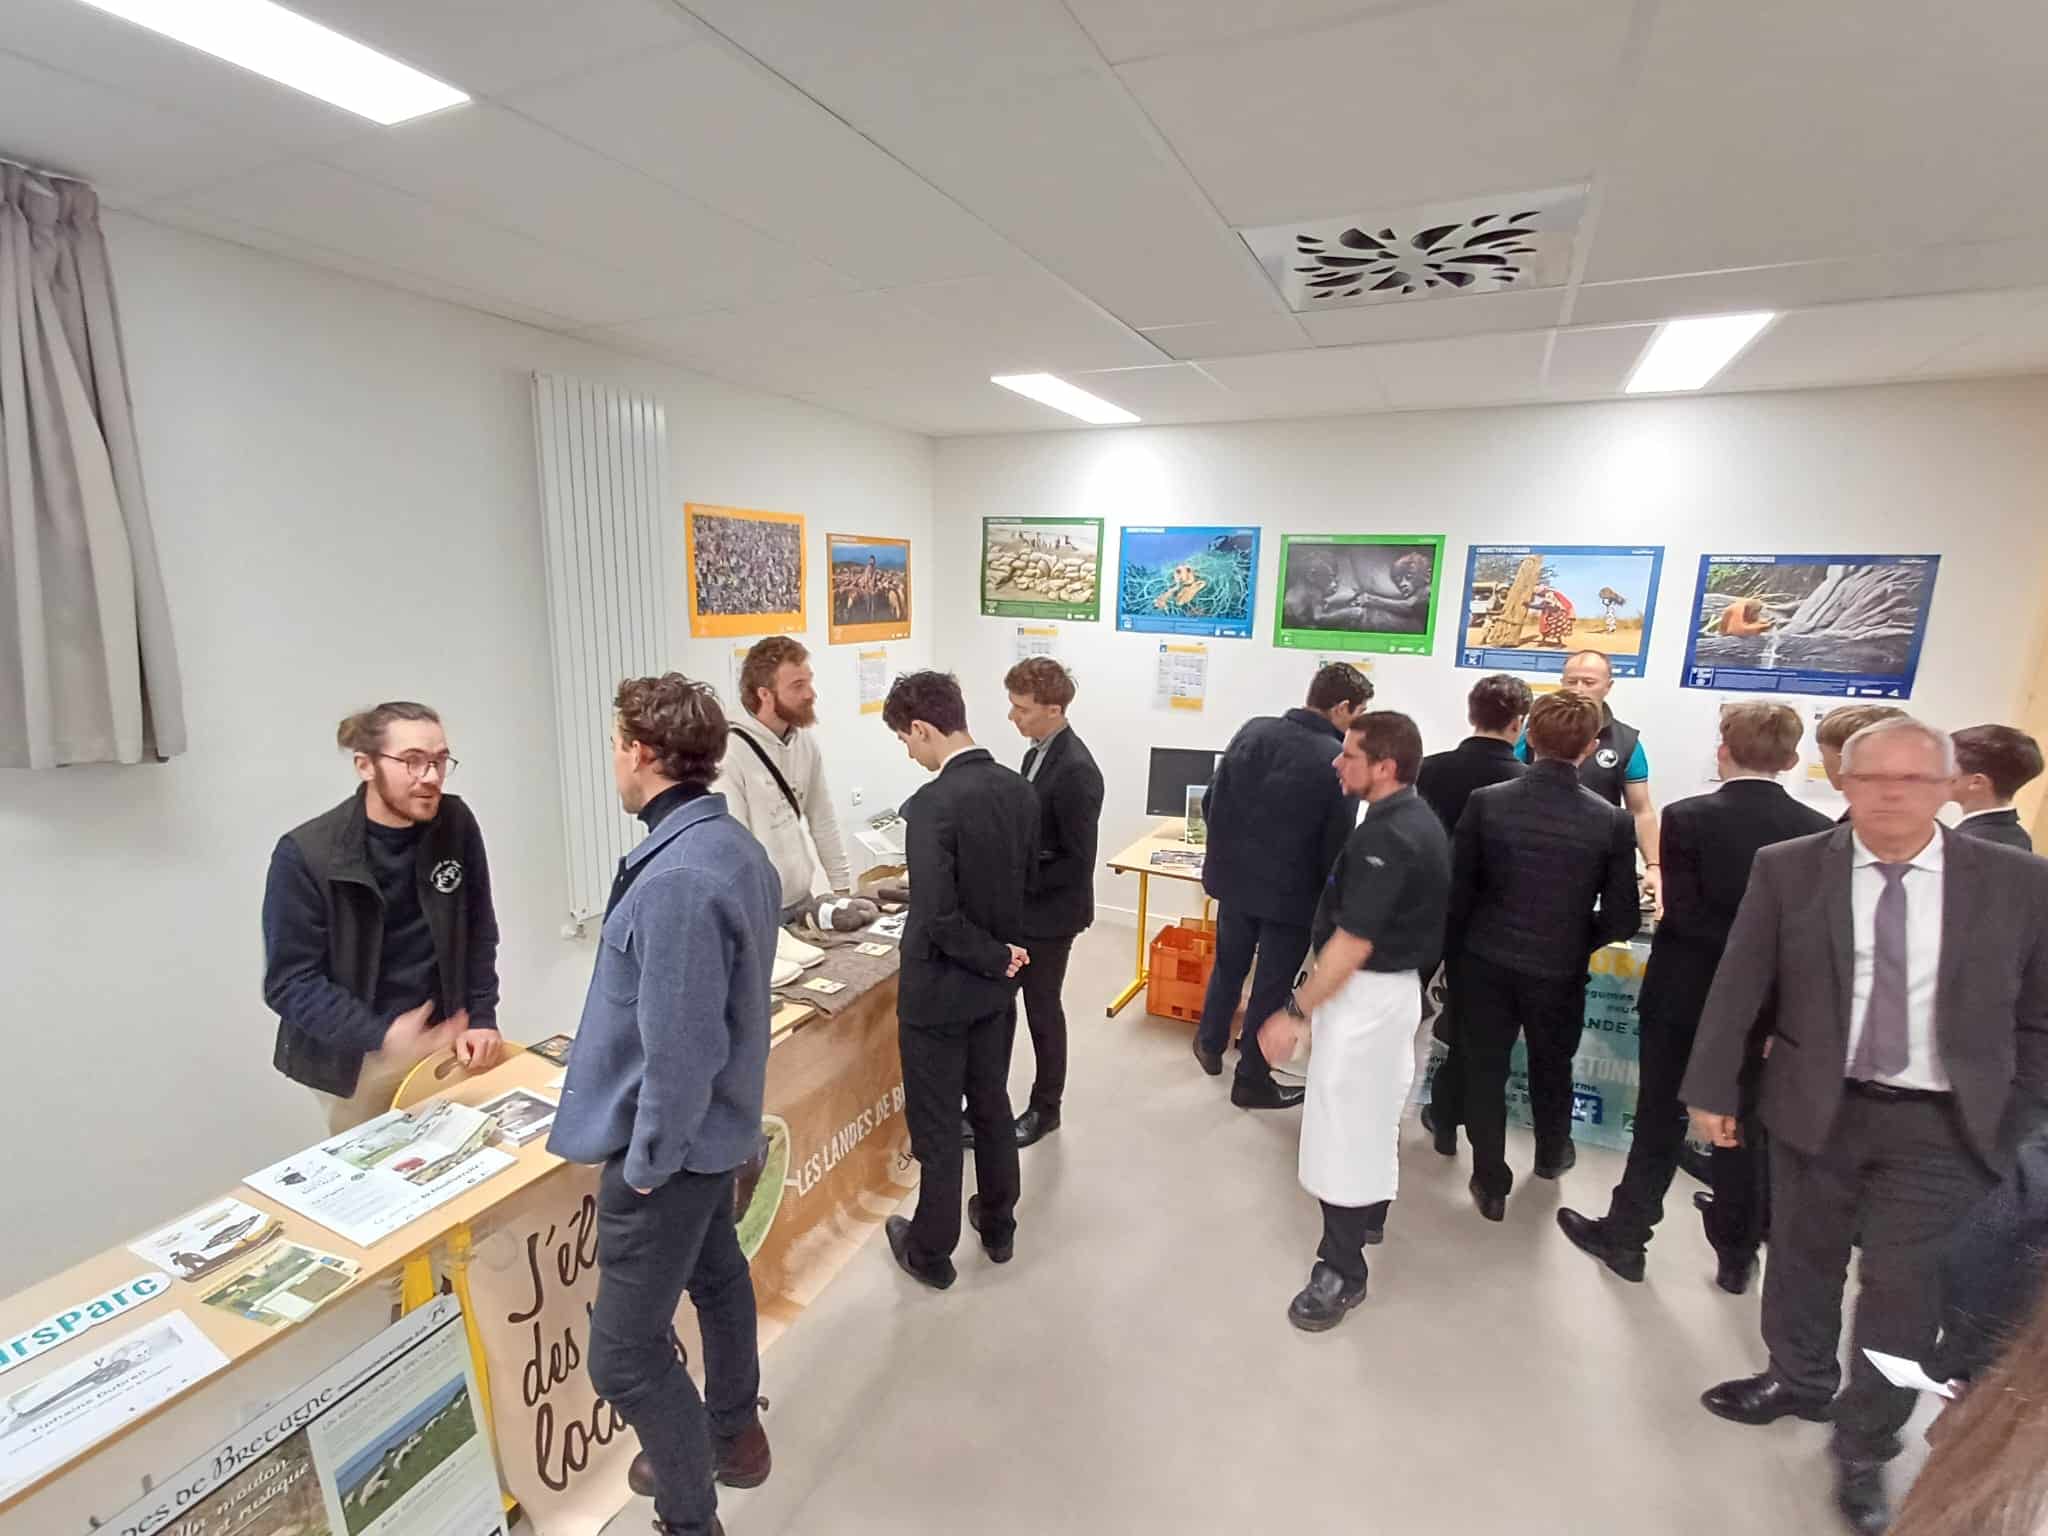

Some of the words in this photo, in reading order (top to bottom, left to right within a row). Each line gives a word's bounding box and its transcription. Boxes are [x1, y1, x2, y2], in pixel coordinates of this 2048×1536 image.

[797, 1152, 821, 1197] LES
[823, 1109, 873, 1172] LANDES
[875, 1093, 891, 1127] DE
[508, 1194, 599, 1323] J'él
[523, 1321, 580, 1407] des
